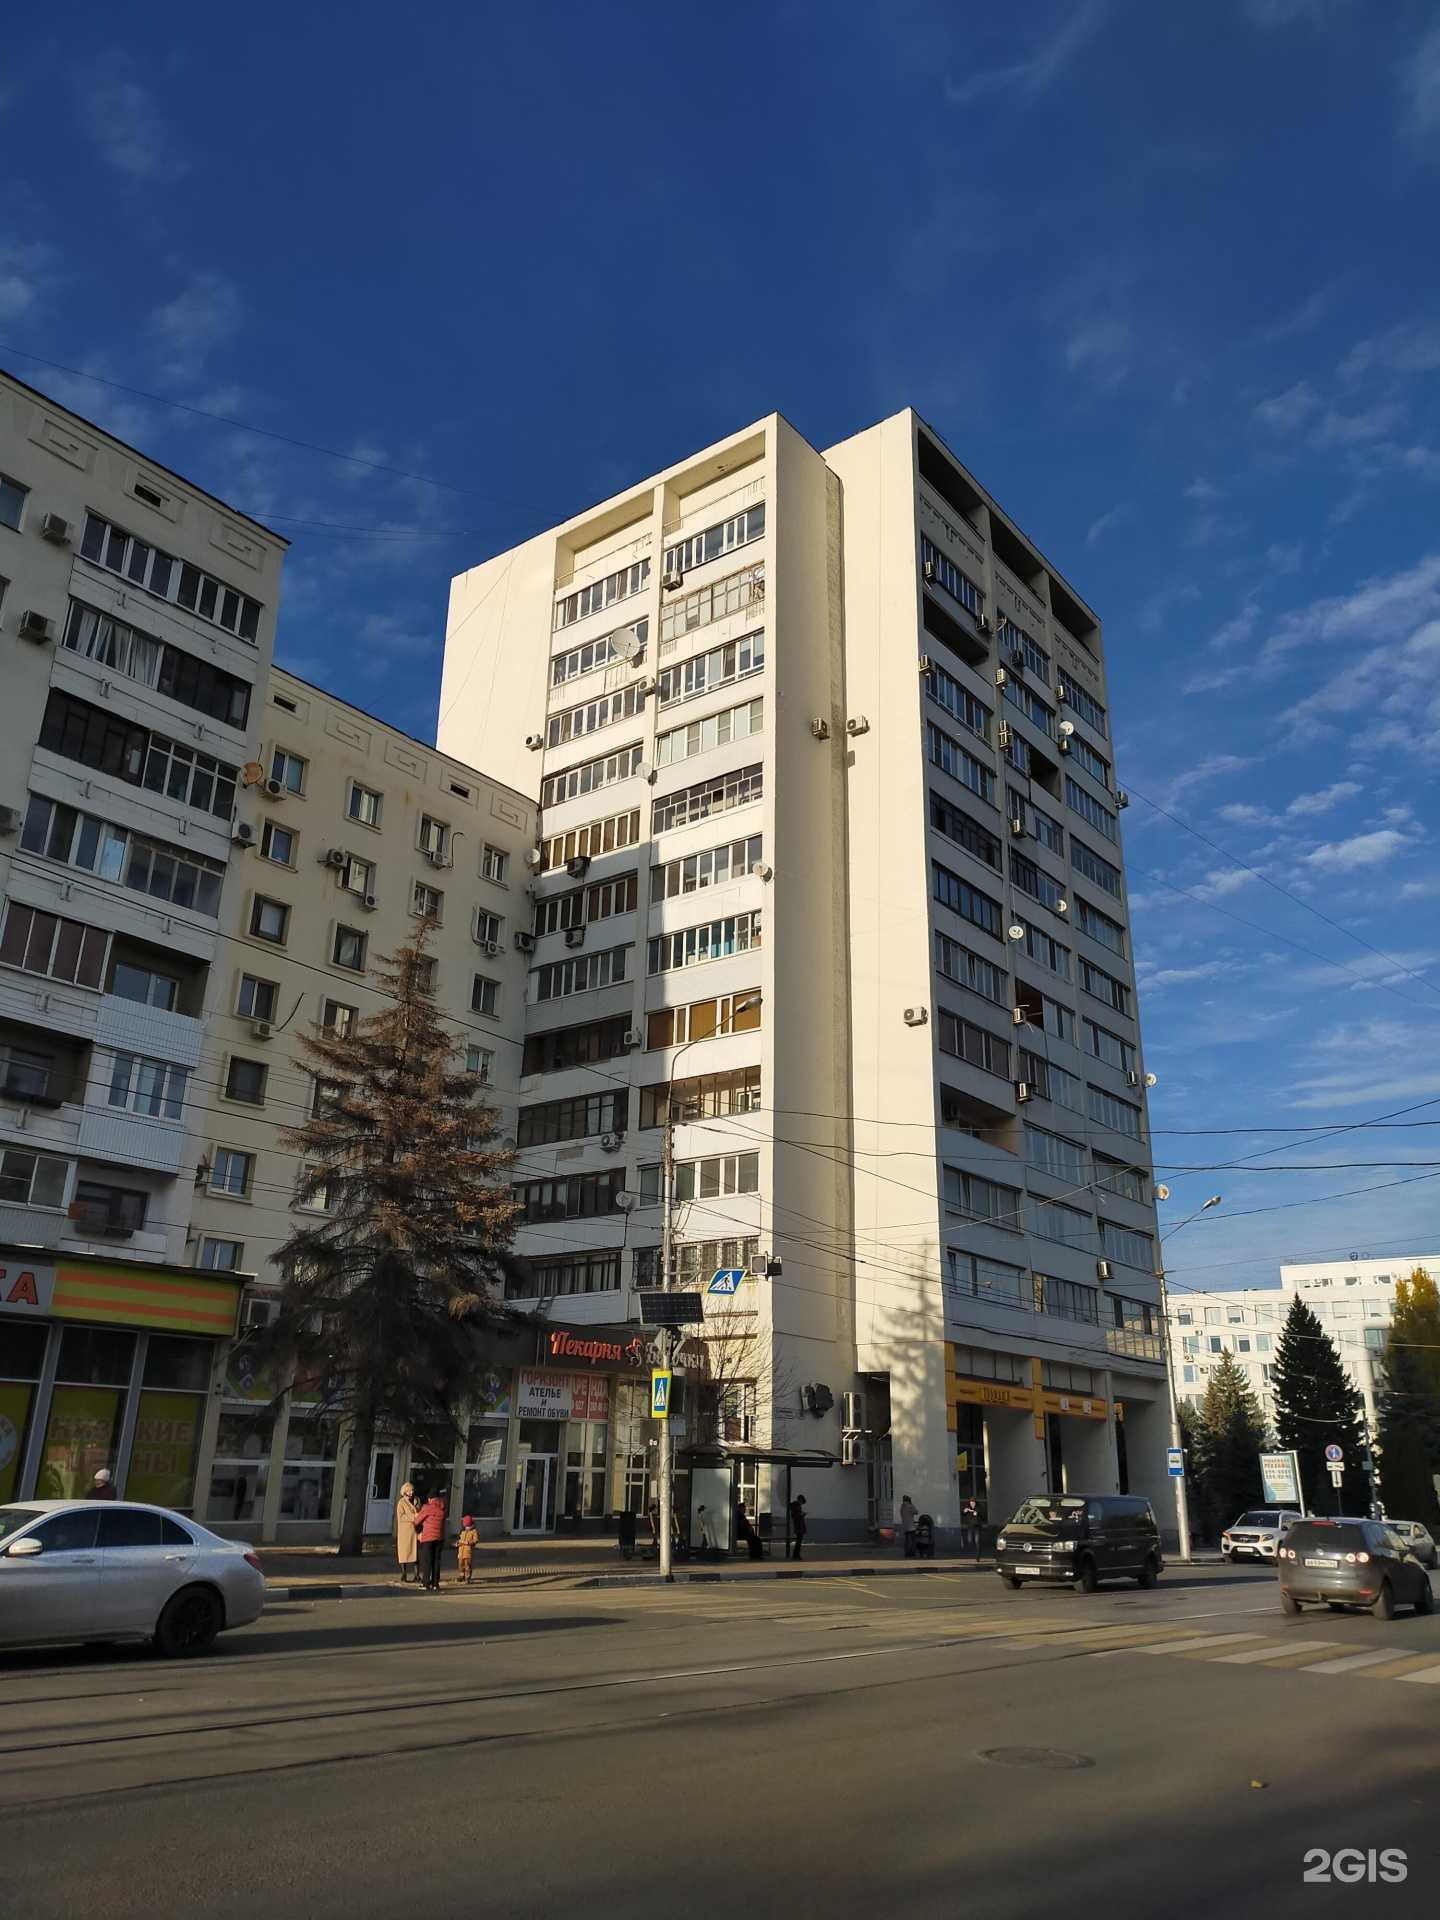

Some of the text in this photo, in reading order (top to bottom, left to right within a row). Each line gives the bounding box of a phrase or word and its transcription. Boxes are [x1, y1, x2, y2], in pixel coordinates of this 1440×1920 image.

[0, 1268, 39, 1305] А
[551, 1331, 622, 1365] Пекарня
[528, 1386, 561, 1399] АТЕЛЬЕ
[541, 1399, 547, 1407] И
[518, 1406, 569, 1418] РЕМОНТ ОБУВИ
